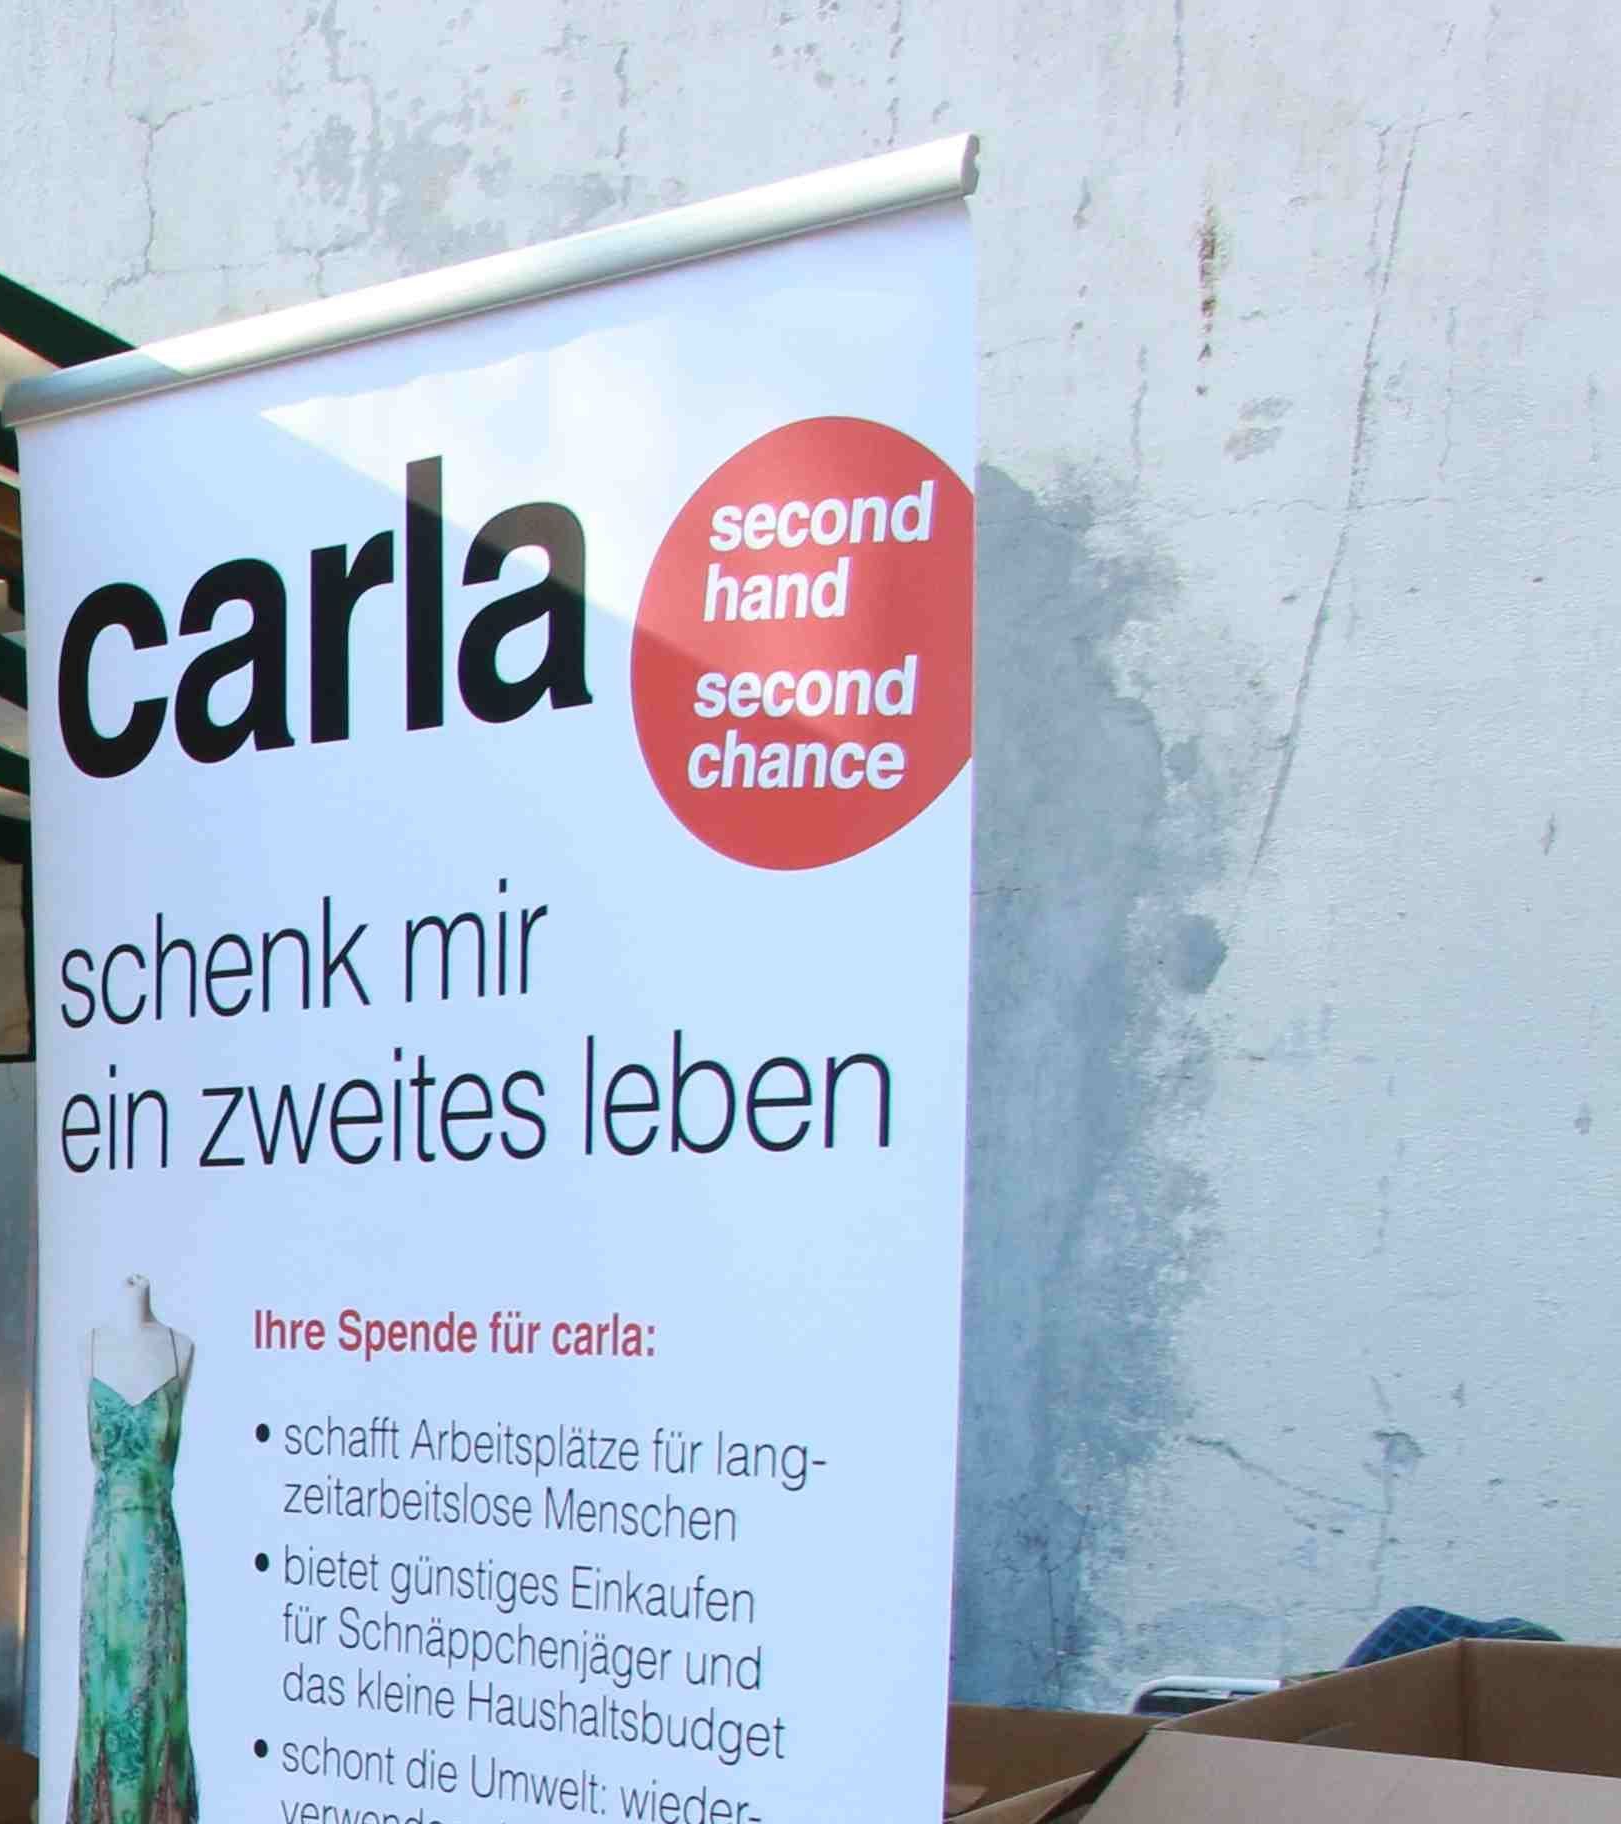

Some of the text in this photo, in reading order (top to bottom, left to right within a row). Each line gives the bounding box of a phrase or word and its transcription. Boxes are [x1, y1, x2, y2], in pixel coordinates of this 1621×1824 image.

[709, 481, 935, 552] second
[58, 455, 593, 779] carla
[704, 557, 851, 623] hand
[694, 654, 917, 719] second
[687, 730, 905, 791] chance
[61, 877, 548, 1029] schenk mir
[60, 1029, 892, 1173] ein zweites leben
[254, 1308, 655, 1361] Ihre Spende für carla:
[284, 1415, 827, 1491] schafft Arbeitsplätze für lang-
[284, 1476, 737, 1542] zeitarbeitslose Menschen
[284, 1545, 754, 1624] bietet günstiges Einkaufen
[283, 1602, 760, 1691] für Schnäppchenjäger und
[283, 1662, 785, 1766] das kleine Haushaltsbudget
[282, 1736, 394, 1786] schont
[407, 1747, 457, 1794] die
[470, 1754, 606, 1815] Umwelt:
